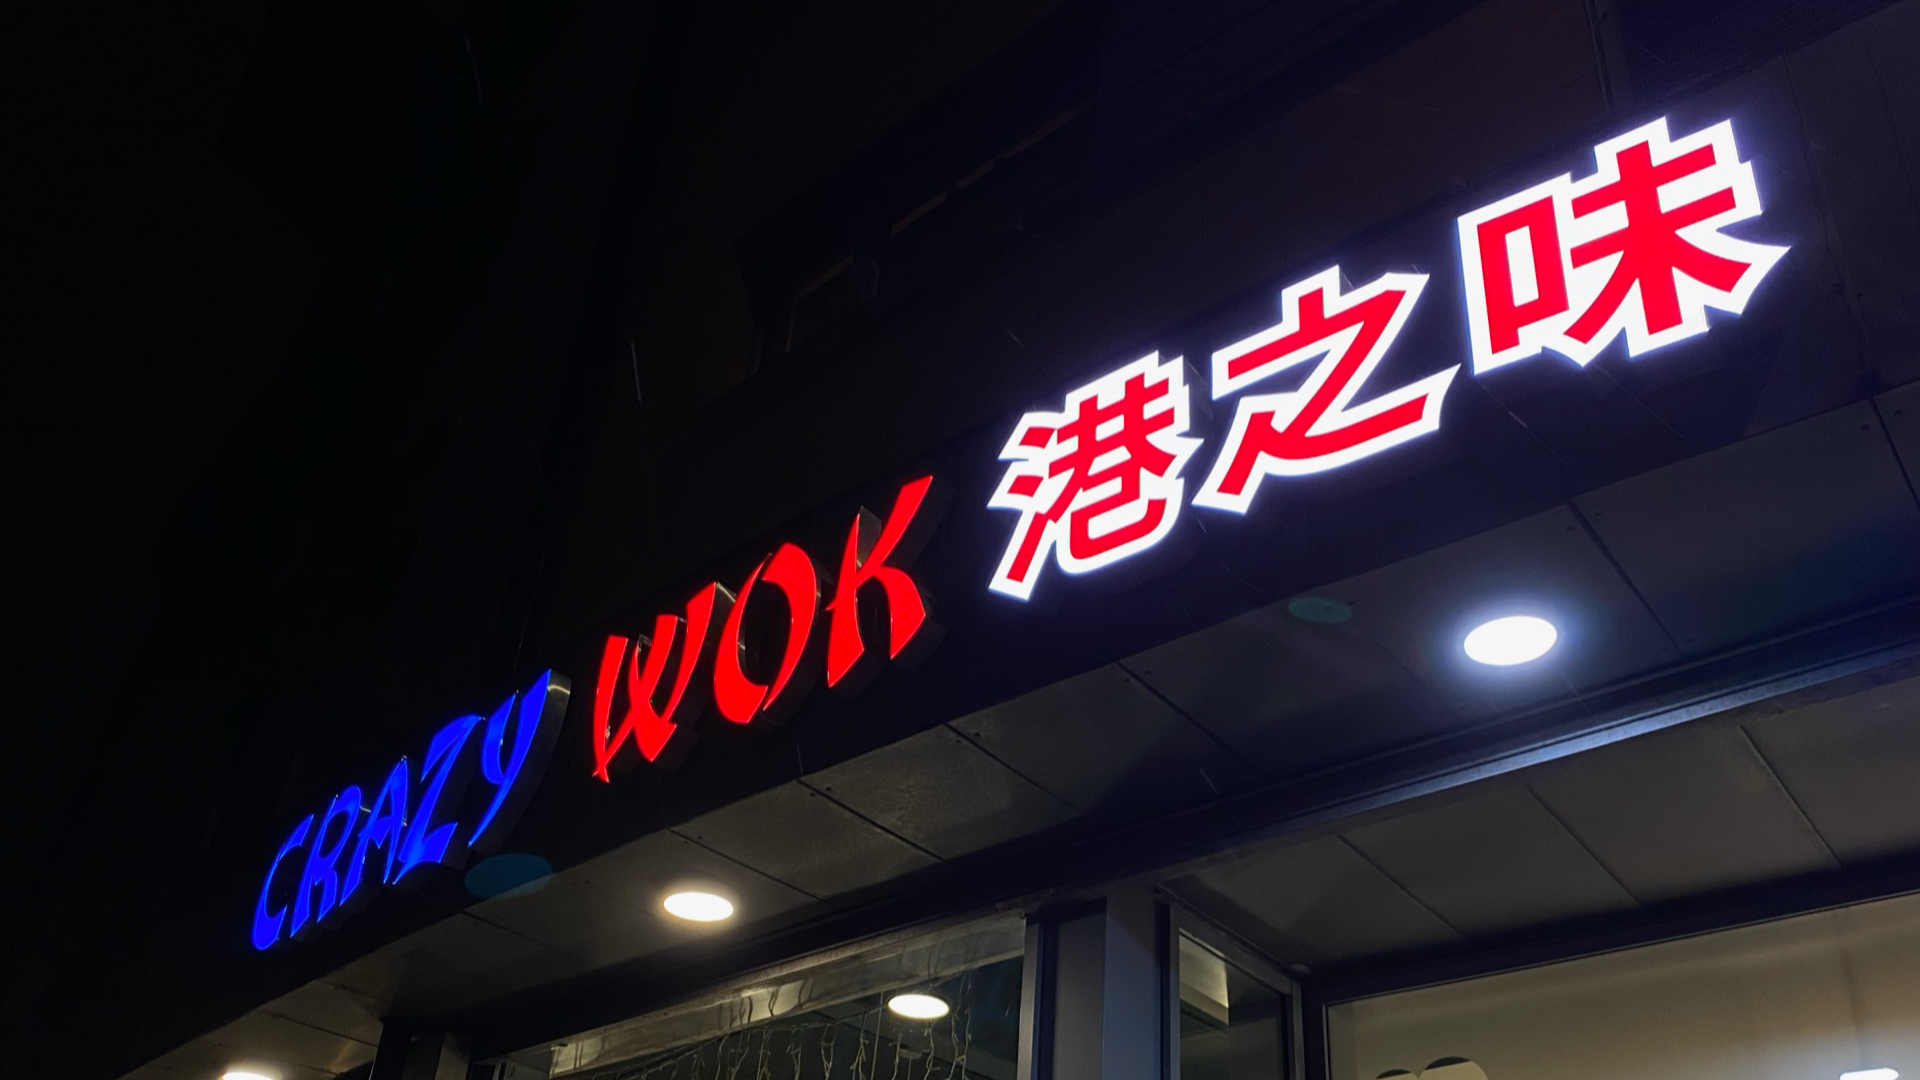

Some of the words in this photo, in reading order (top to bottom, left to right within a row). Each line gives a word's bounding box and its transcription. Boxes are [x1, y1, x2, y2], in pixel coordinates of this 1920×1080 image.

[988, 117, 1789, 601] 港之味
[252, 669, 553, 951] CRAZY
[592, 475, 933, 783] WOK
